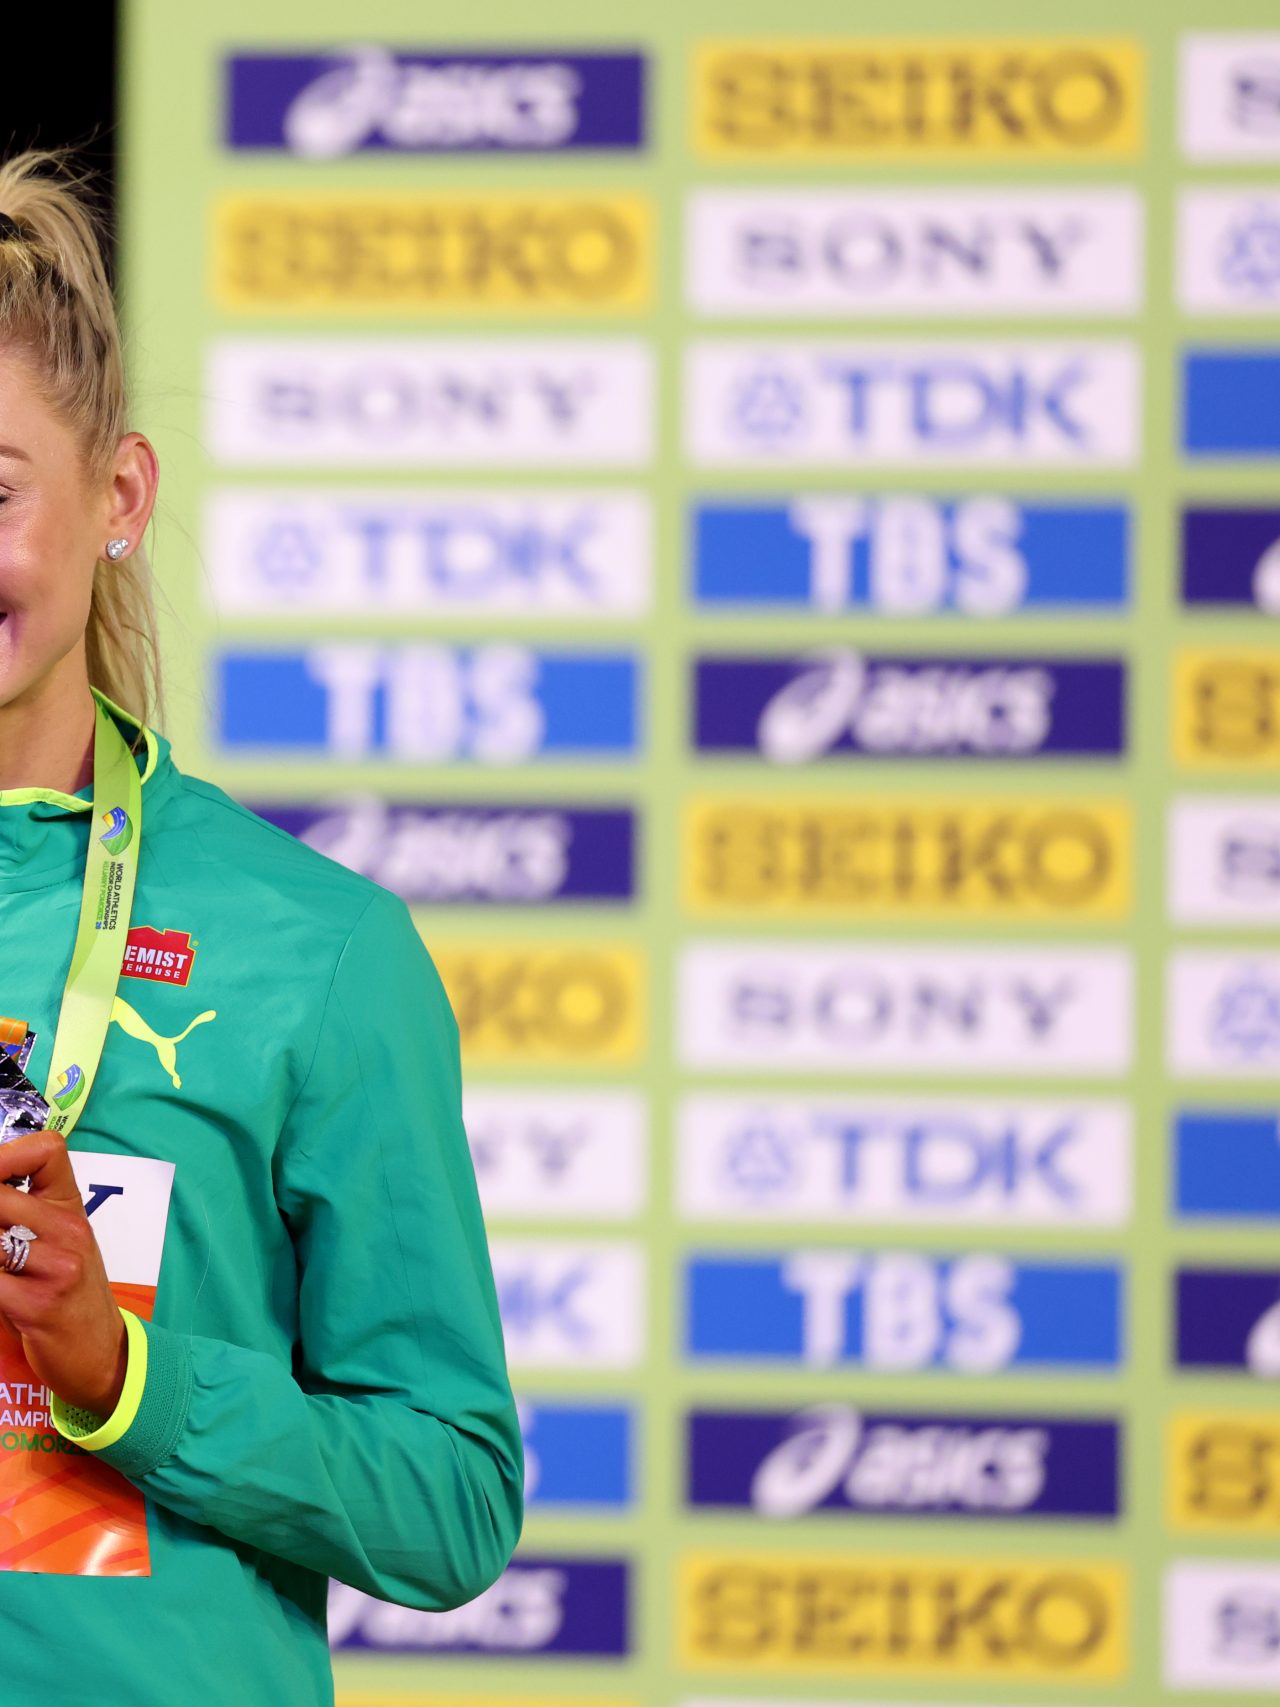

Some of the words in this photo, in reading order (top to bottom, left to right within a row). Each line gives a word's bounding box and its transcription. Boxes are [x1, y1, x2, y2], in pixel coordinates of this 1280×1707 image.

[710, 50, 1126, 149] SEIKO
[230, 204, 638, 301] SEIKO
[734, 210, 1086, 292] SONY
[254, 361, 598, 440] SONY
[818, 354, 1092, 452] TDK
[338, 505, 604, 602] TDK
[786, 490, 1030, 618] TBS
[305, 641, 544, 765] TBS
[114, 863, 124, 890] WORLD
[699, 810, 1113, 907] SEIKO
[108, 891, 120, 931] ATHLETICS
[124, 945, 189, 970] EMIST
[121, 963, 181, 979] EHOUSE
[728, 968, 1076, 1047] SONY
[811, 1111, 1083, 1205] TDK
[781, 1250, 1022, 1374] TBS
[844, 1424, 1050, 1510] asics
[693, 1564, 1109, 1668] SEIKO
